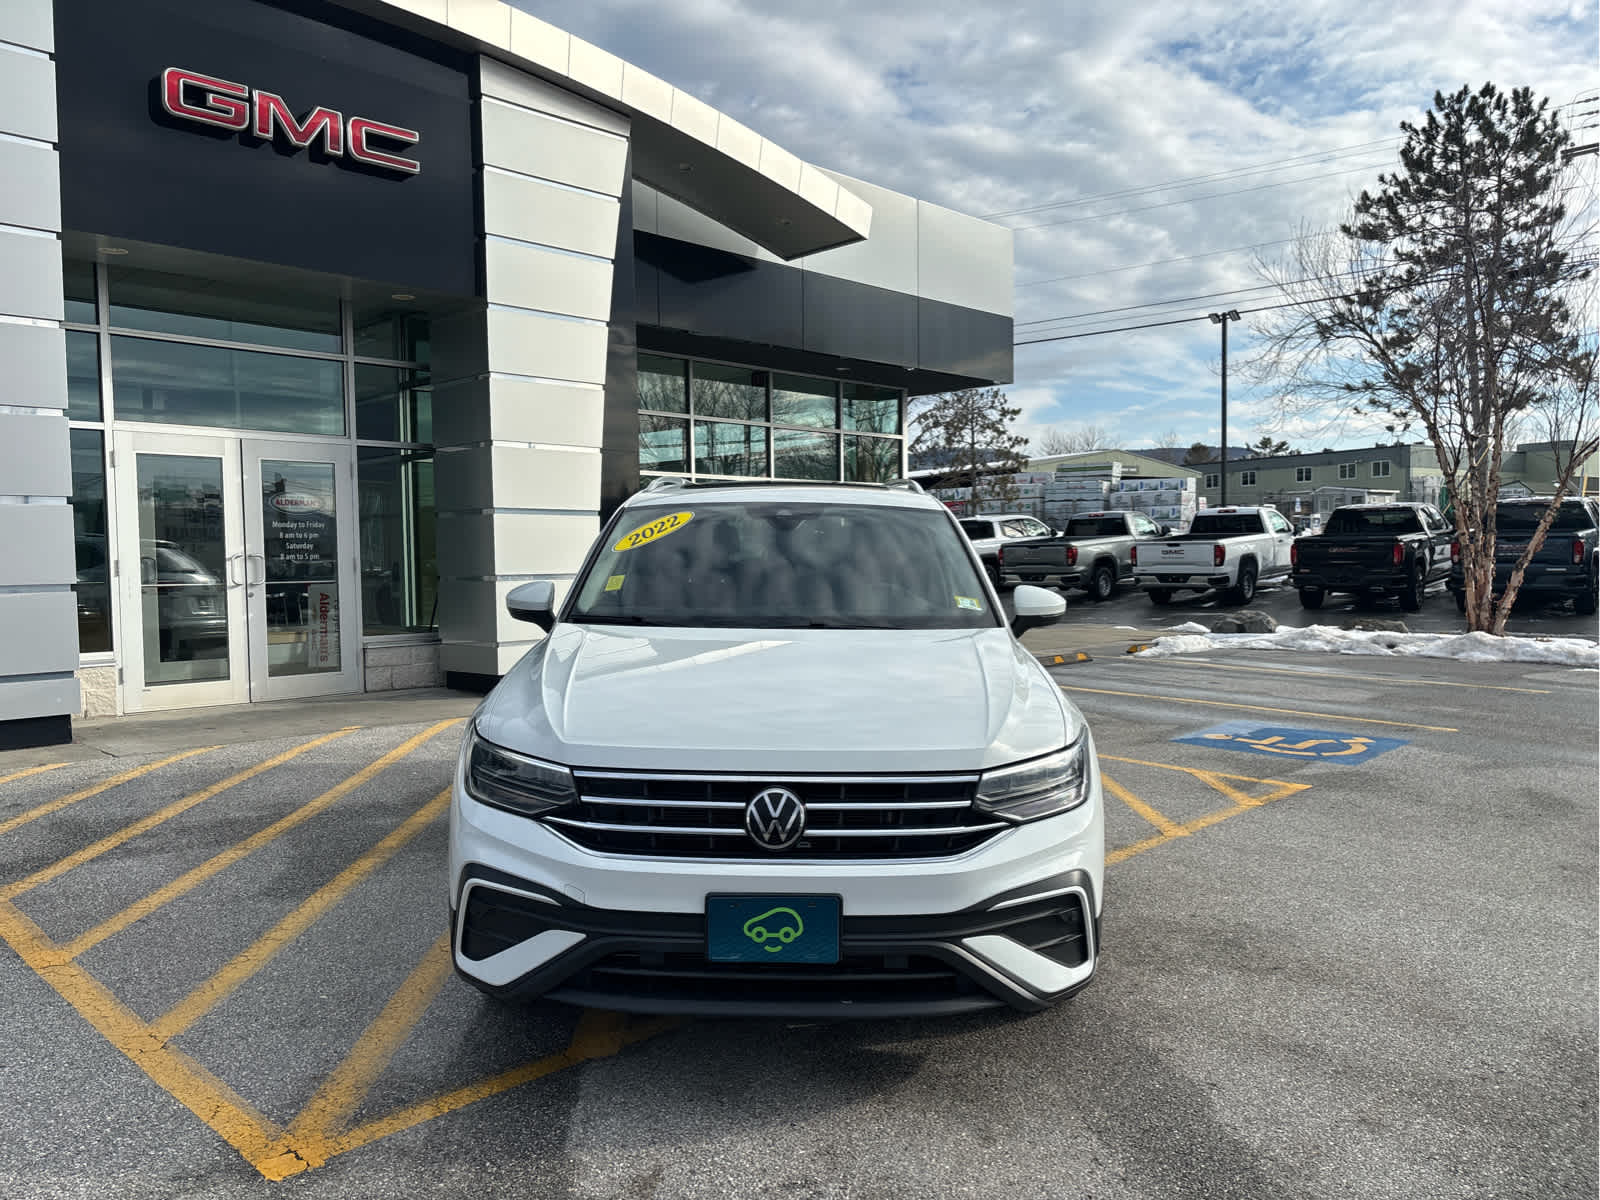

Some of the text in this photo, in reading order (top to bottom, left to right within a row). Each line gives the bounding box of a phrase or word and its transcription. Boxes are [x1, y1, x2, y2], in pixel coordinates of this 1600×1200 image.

[161, 67, 420, 174] GMC
[272, 520, 297, 529] Monday
[306, 520, 325, 529] Friday
[628, 515, 681, 546] 2022
[286, 542, 314, 550] Saturday
